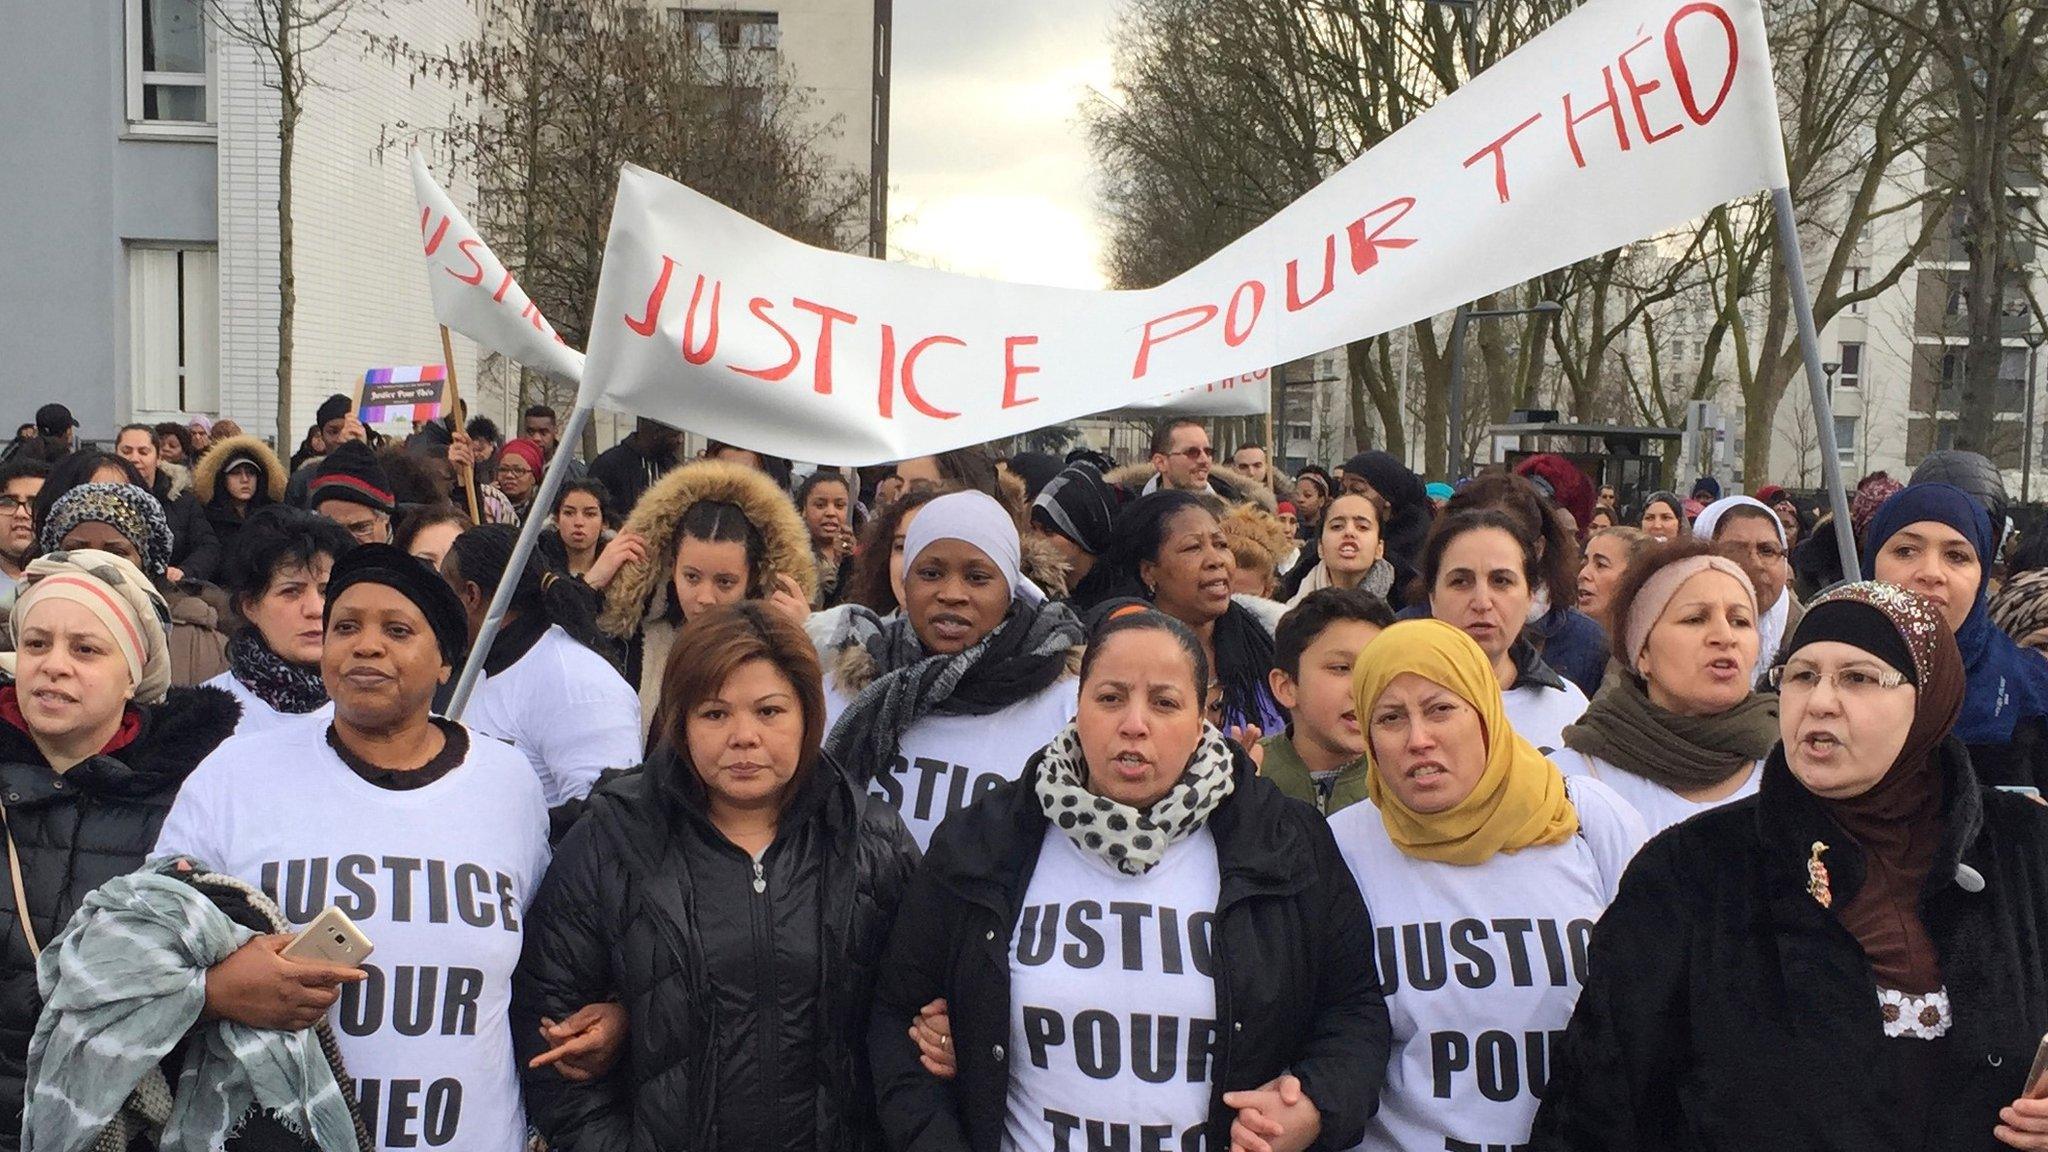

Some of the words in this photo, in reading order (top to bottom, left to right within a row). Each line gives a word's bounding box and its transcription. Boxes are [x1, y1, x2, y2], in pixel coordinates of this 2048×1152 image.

[623, 255, 1042, 420] JUSTICE
[1133, 197, 1416, 380] POUR
[1462, 2, 1740, 204] THÉO
[1016, 899, 1216, 979] USTIC
[1376, 917, 1595, 996] JUSTIC
[339, 963, 485, 1037] OUR
[1430, 1029, 1568, 1103] POU
[350, 1077, 463, 1148] HEO
